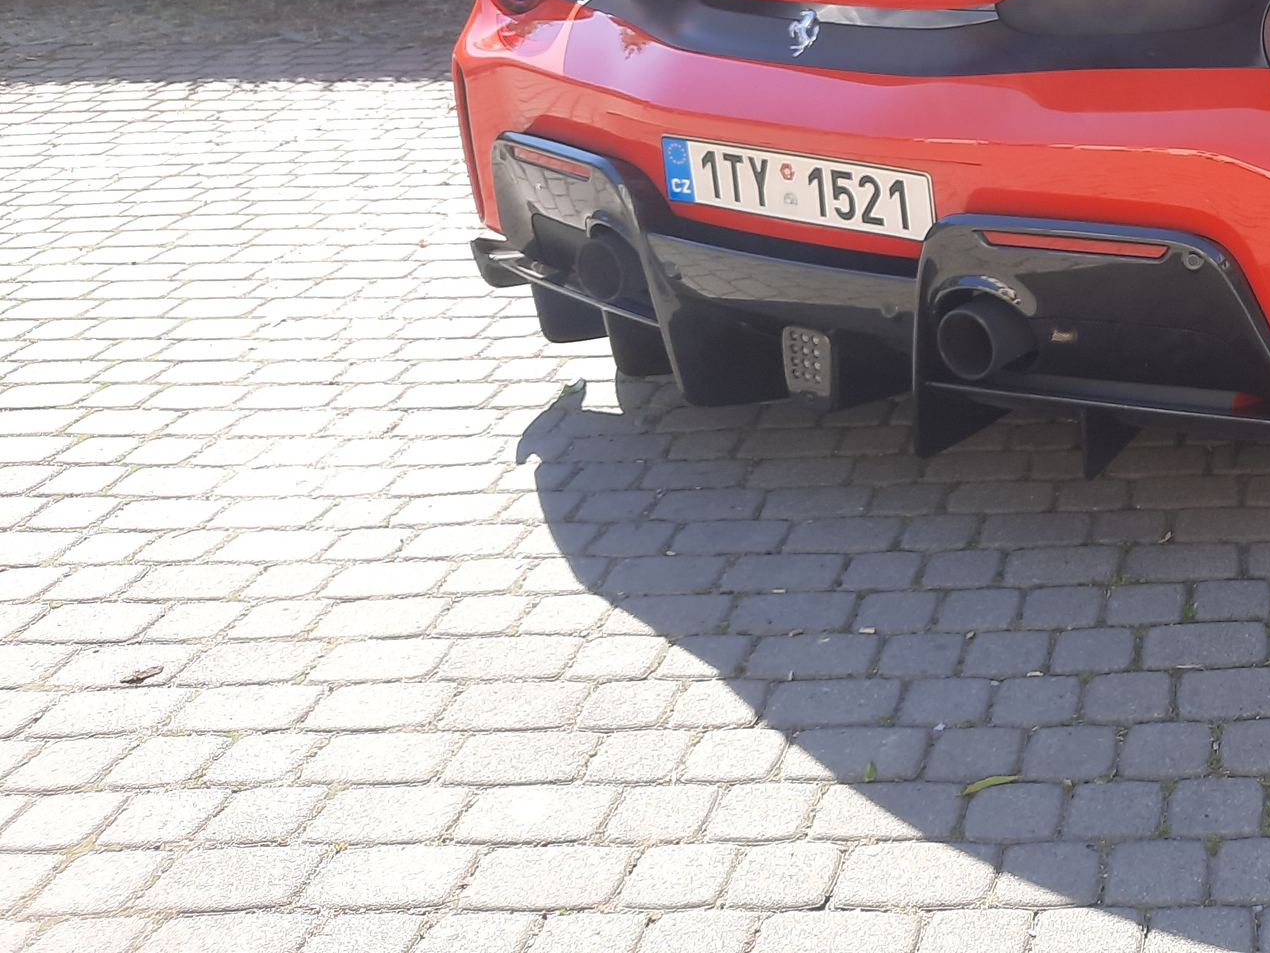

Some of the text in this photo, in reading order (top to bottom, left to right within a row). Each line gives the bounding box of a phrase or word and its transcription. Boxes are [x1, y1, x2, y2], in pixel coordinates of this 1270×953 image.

[671, 178, 692, 194] CZ
[701, 150, 911, 231] 1TY 1521
